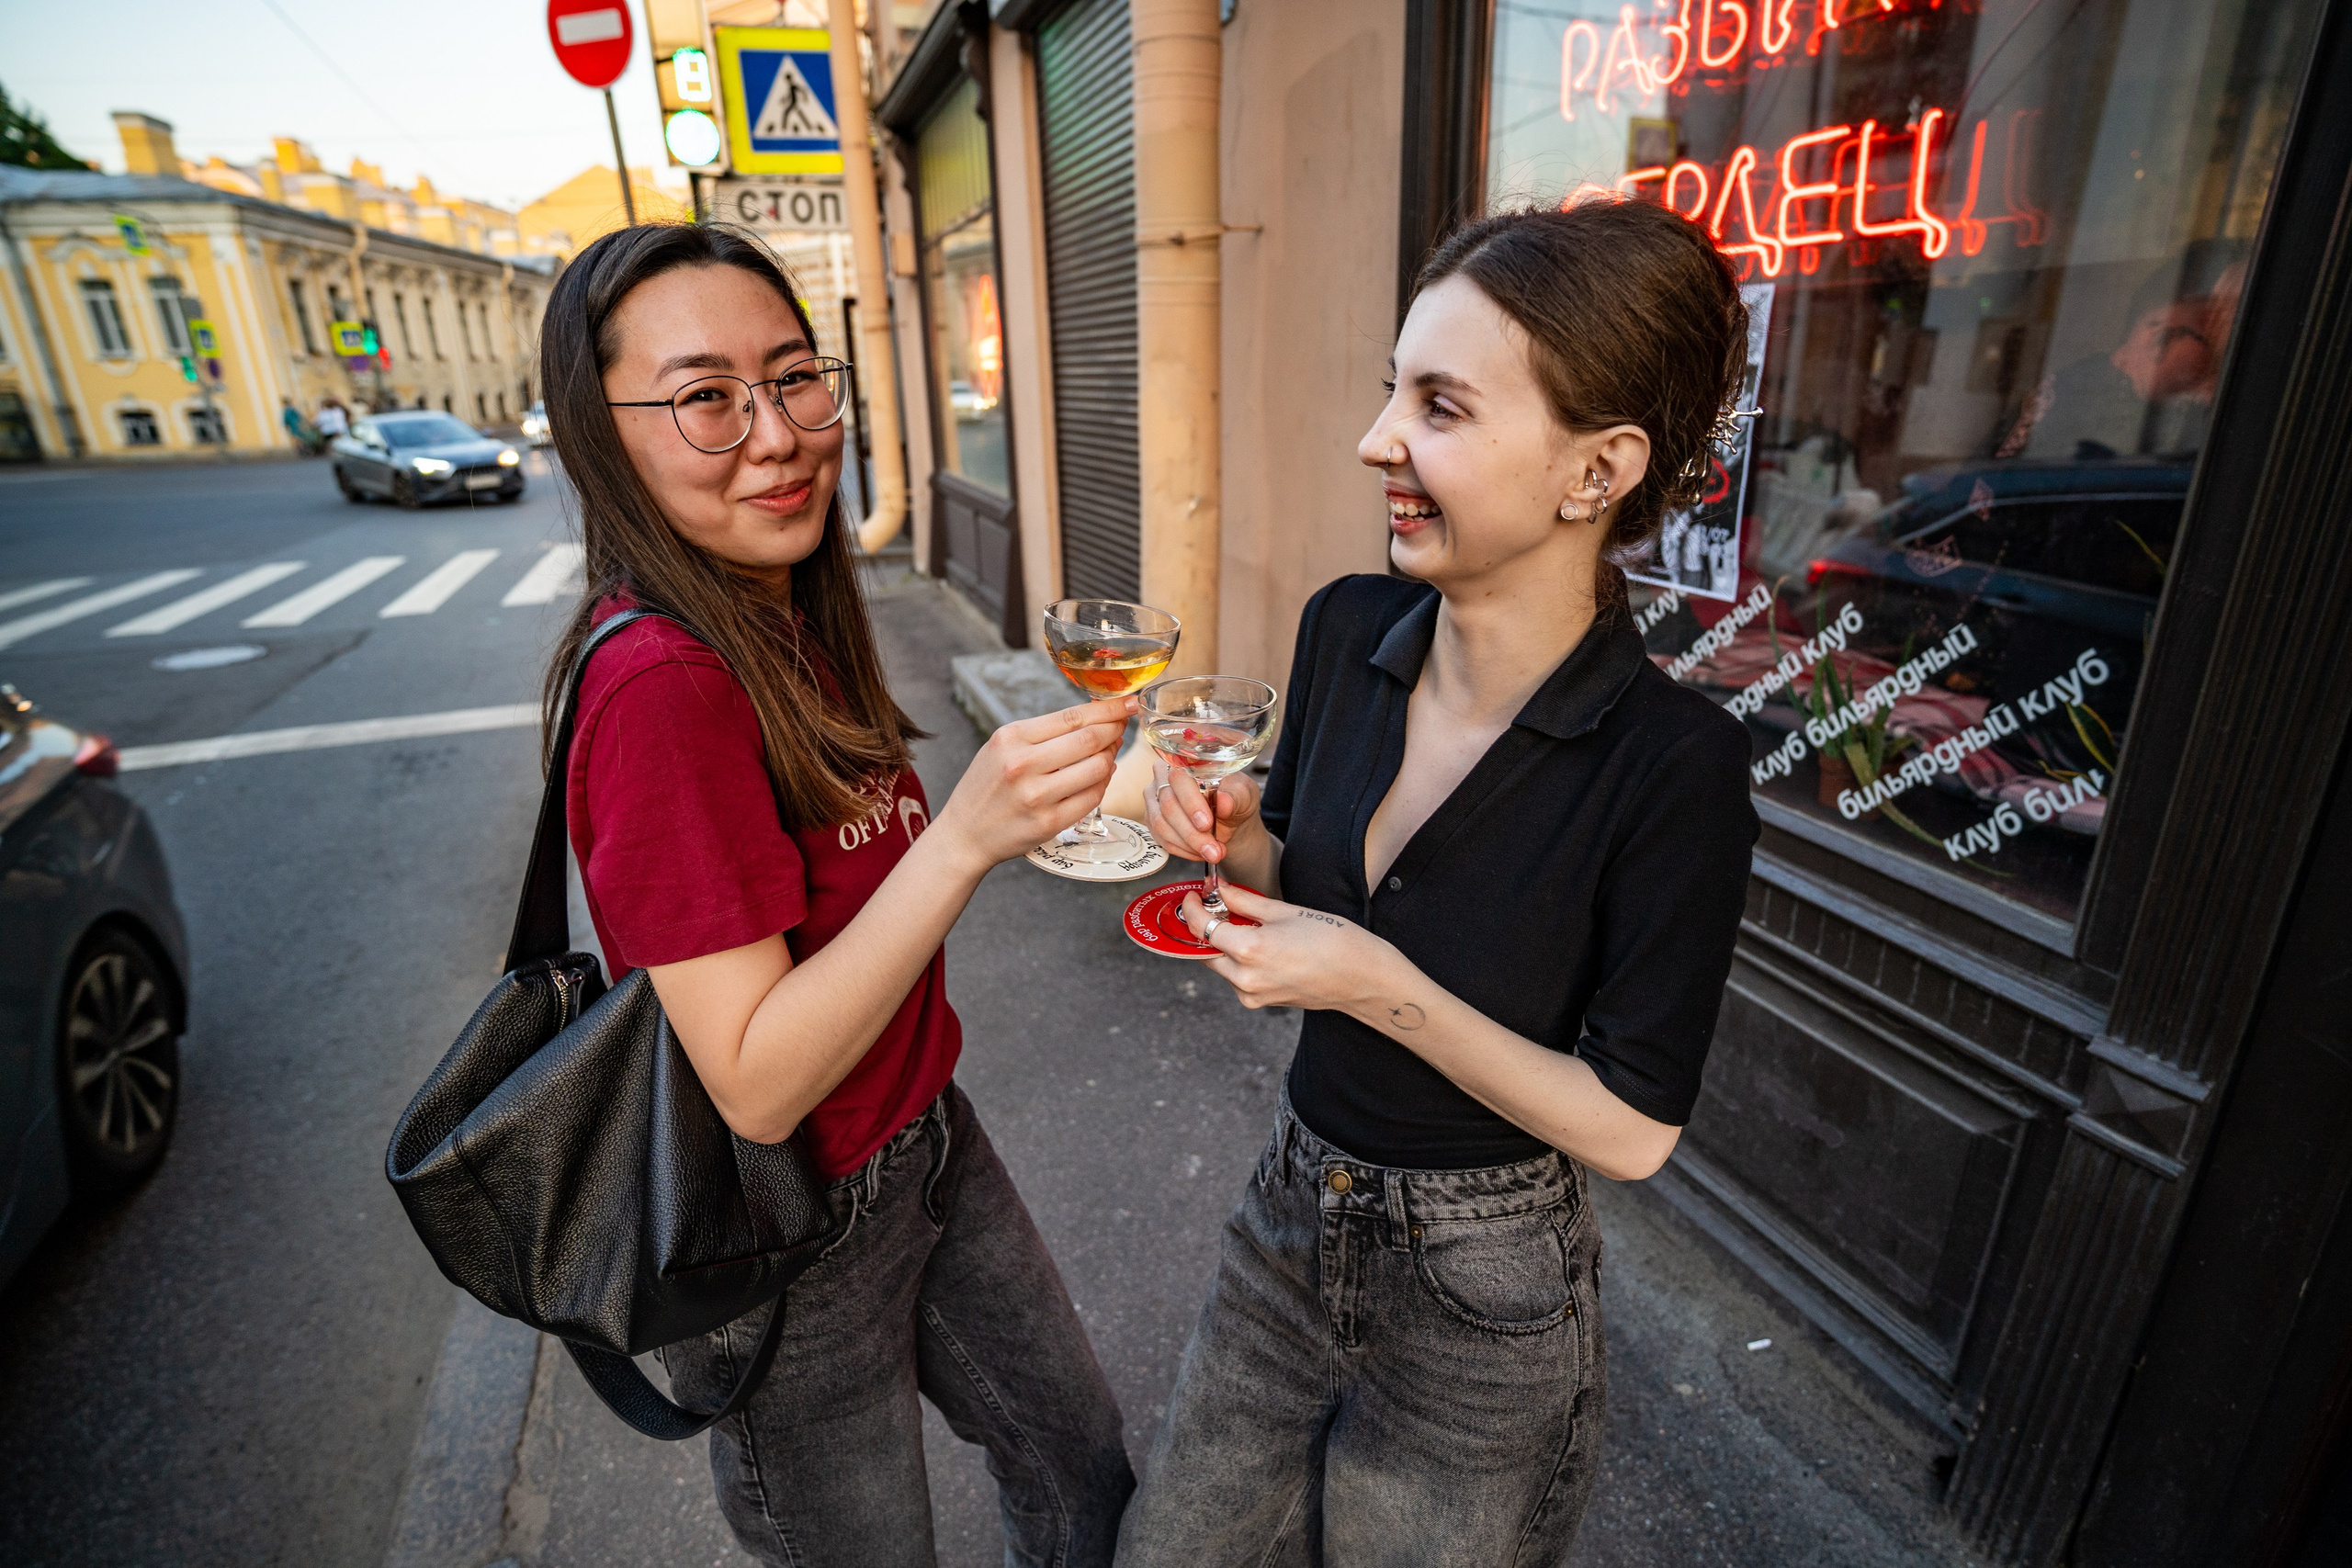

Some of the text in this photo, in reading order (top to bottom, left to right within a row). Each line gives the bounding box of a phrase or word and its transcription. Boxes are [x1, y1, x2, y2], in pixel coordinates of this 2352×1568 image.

[737, 189, 842, 224] СТОП
[1561, 107, 1949, 277] РДЕЦ
[1644, 588, 1688, 626] клу
[1663, 582, 1772, 682] ильярдный
[1801, 601, 1864, 665] клуб
[1750, 622, 1978, 785] клуб бильярдный
[1838, 648, 2110, 820] бильярдный клуб
[1942, 801, 2022, 861] клуб
[1128, 884, 1203, 942] бар разбитых сердец
[1297, 909, 1345, 929] ADORE
